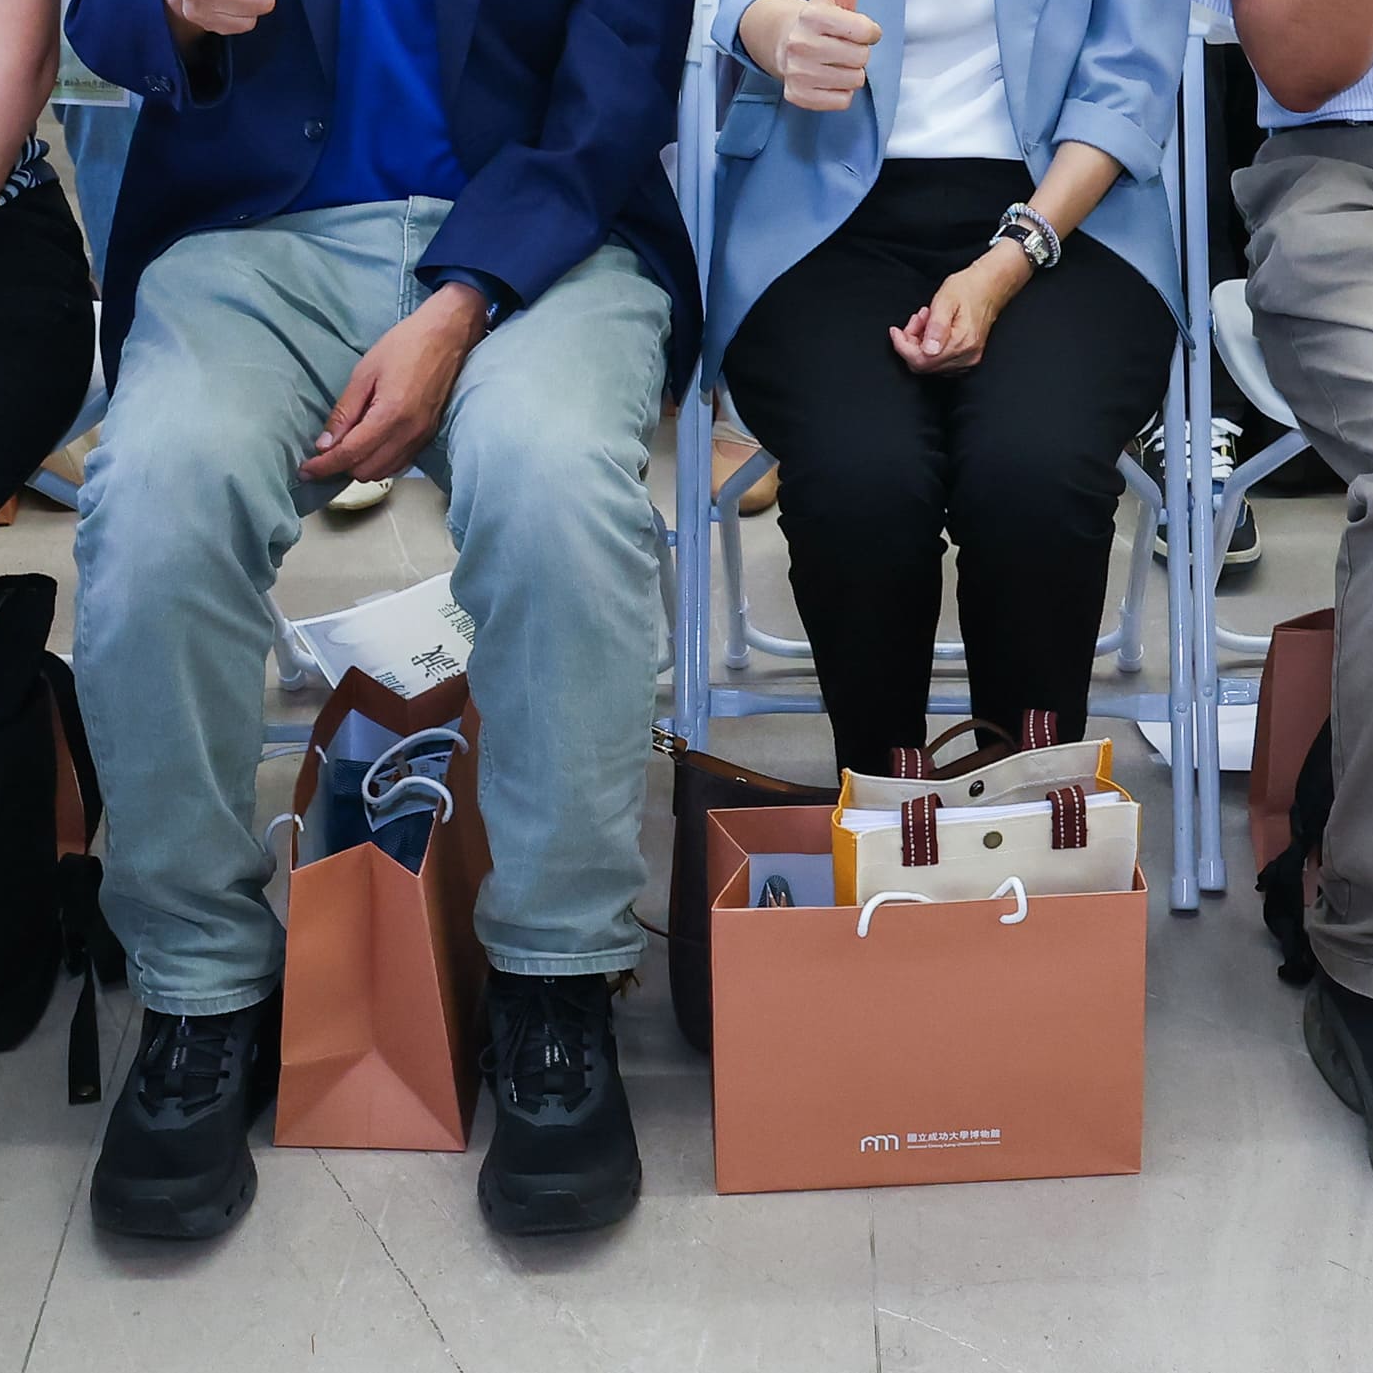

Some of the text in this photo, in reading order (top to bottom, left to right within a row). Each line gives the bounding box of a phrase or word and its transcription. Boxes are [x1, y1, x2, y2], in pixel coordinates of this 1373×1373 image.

[906, 1128, 1001, 1143] 國立成功大學博物館
